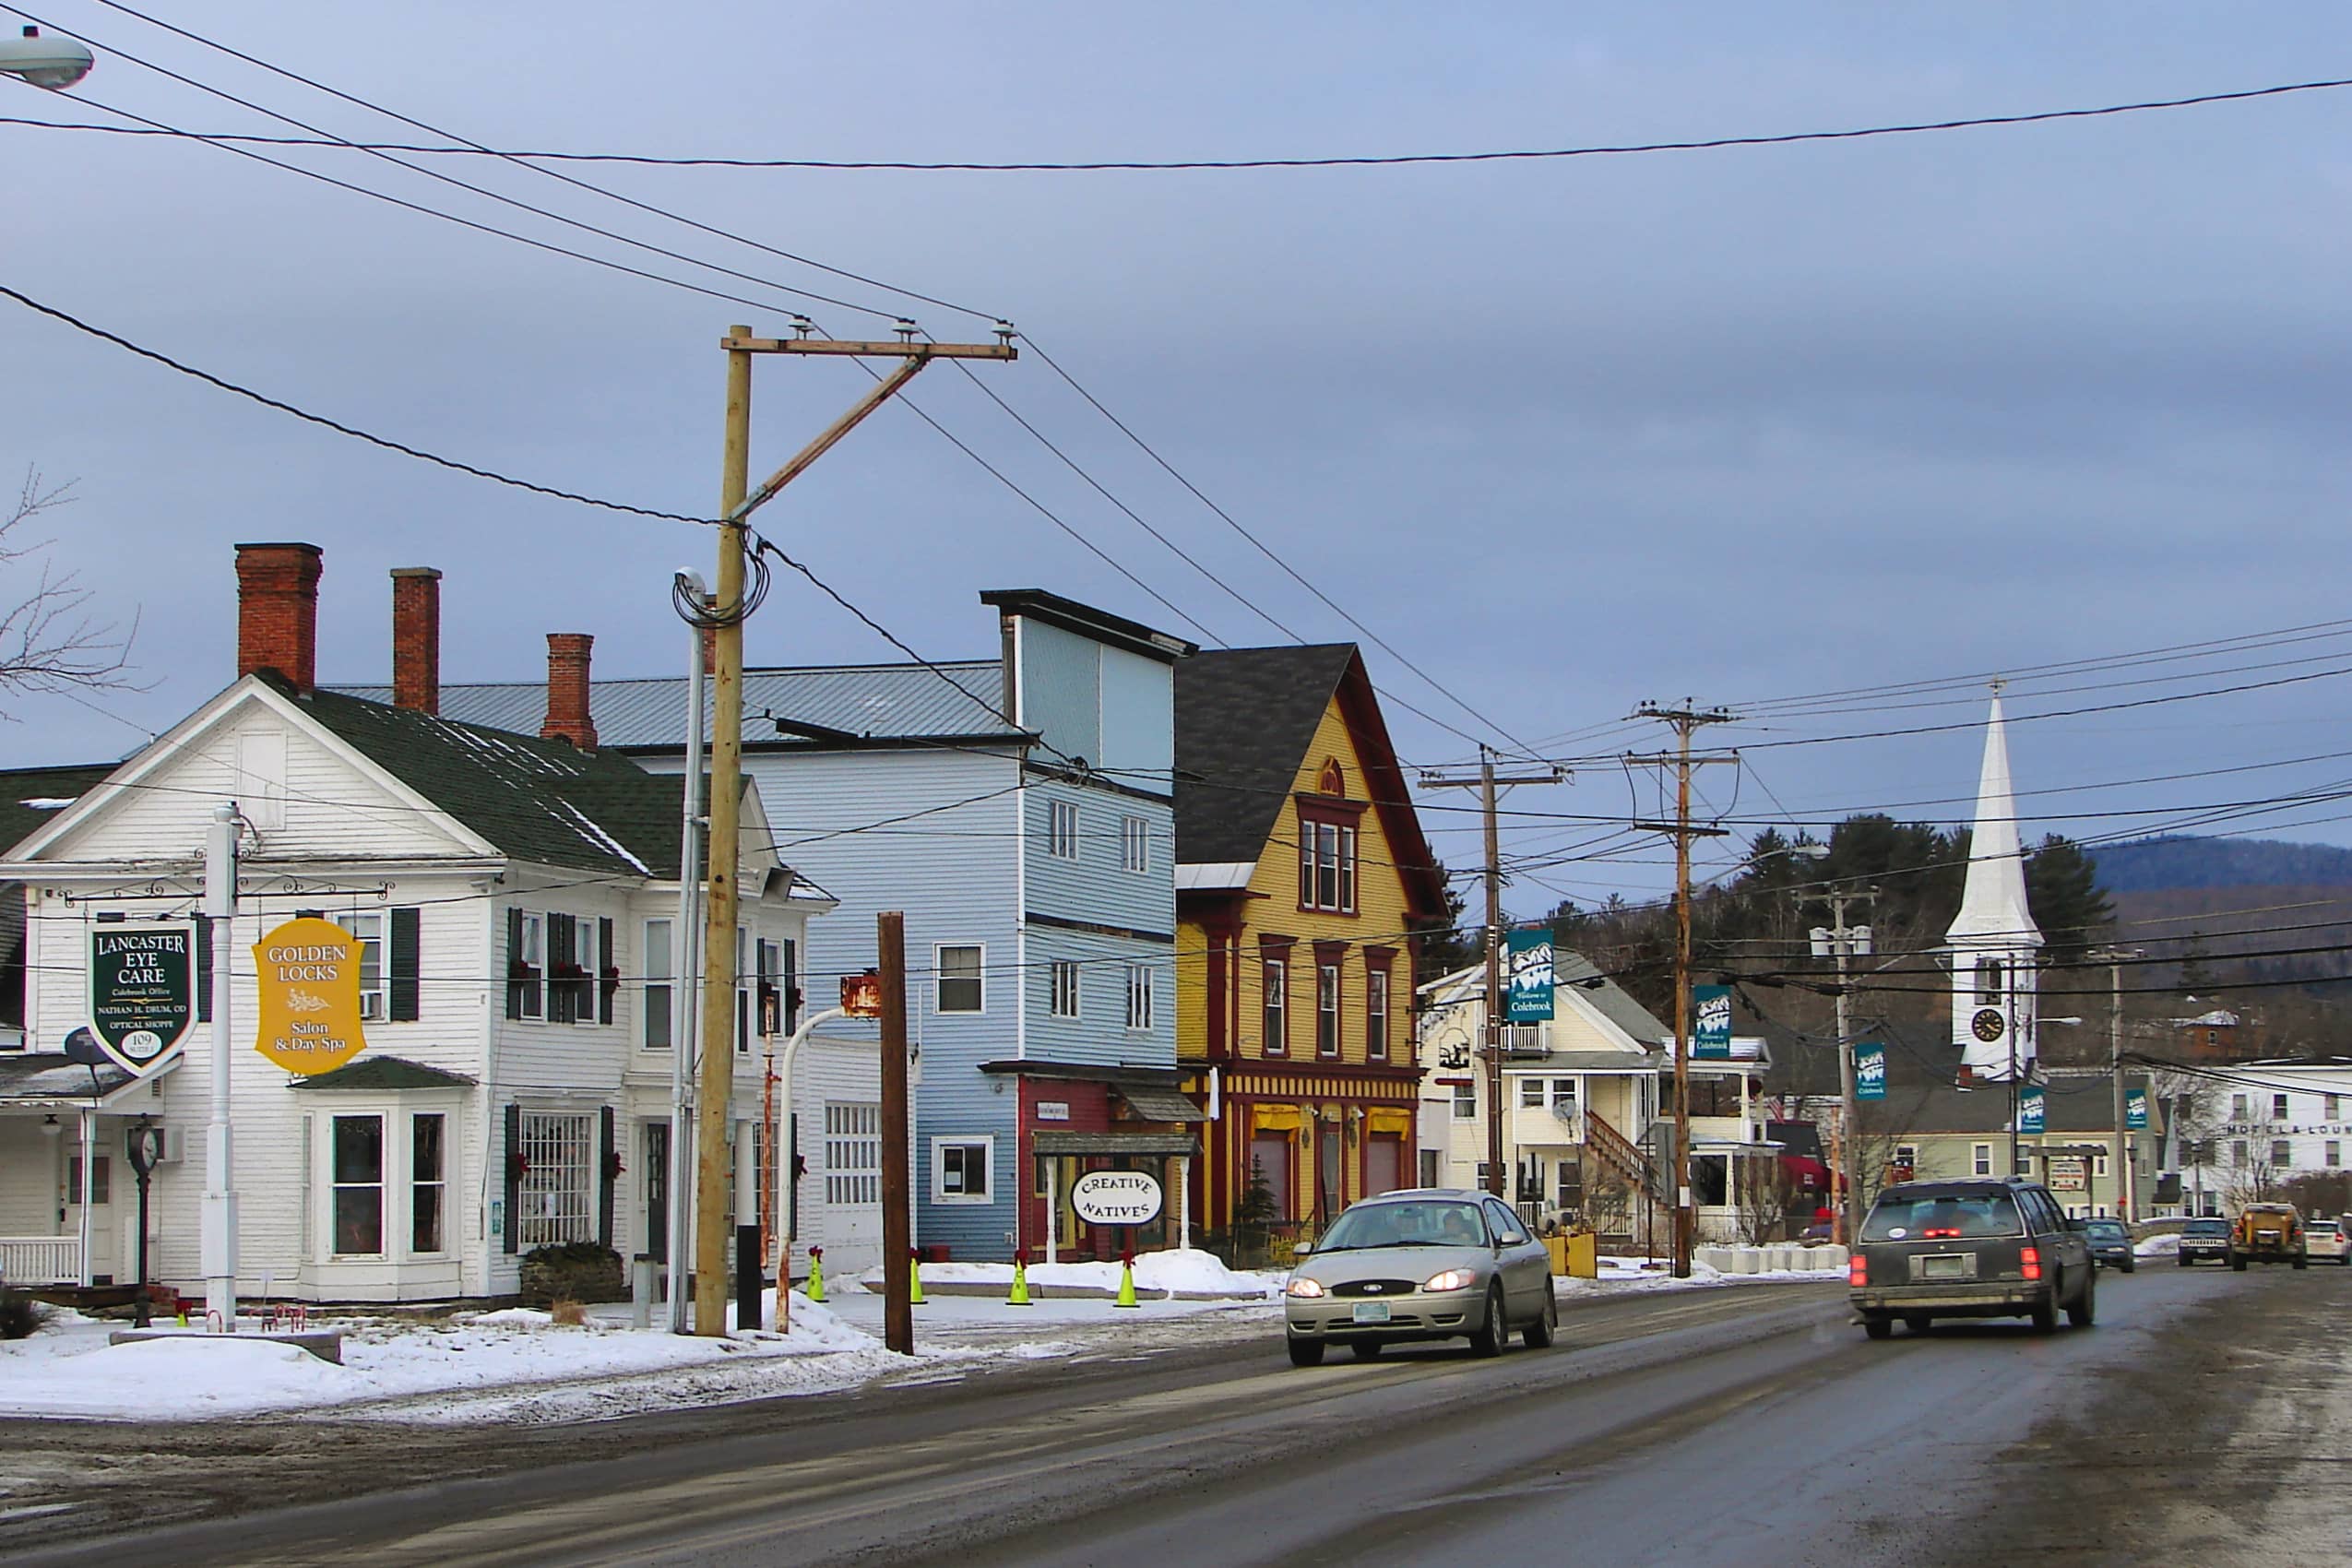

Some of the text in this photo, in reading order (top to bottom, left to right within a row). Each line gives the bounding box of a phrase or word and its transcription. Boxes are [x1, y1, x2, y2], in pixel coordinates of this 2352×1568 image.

[97, 935, 184, 956] LANCASTER
[125, 953, 158, 967] EYE
[268, 945, 347, 963] GOLDEN
[118, 968, 166, 984] CARE
[279, 965, 339, 981] LOCKS
[98, 1006, 133, 1015] NATHAN
[1511, 1002, 1551, 1012] Colebrook
[109, 1021, 143, 1029] OPTICAL
[291, 1021, 328, 1034] Salon
[133, 1034, 152, 1046] 109
[276, 1037, 346, 1052] & Day Spa
[2227, 1124, 2287, 1134] MOTEL
[1081, 1178, 1152, 1194] CREATIVE
[1083, 1202, 1150, 1218] NATIVES
